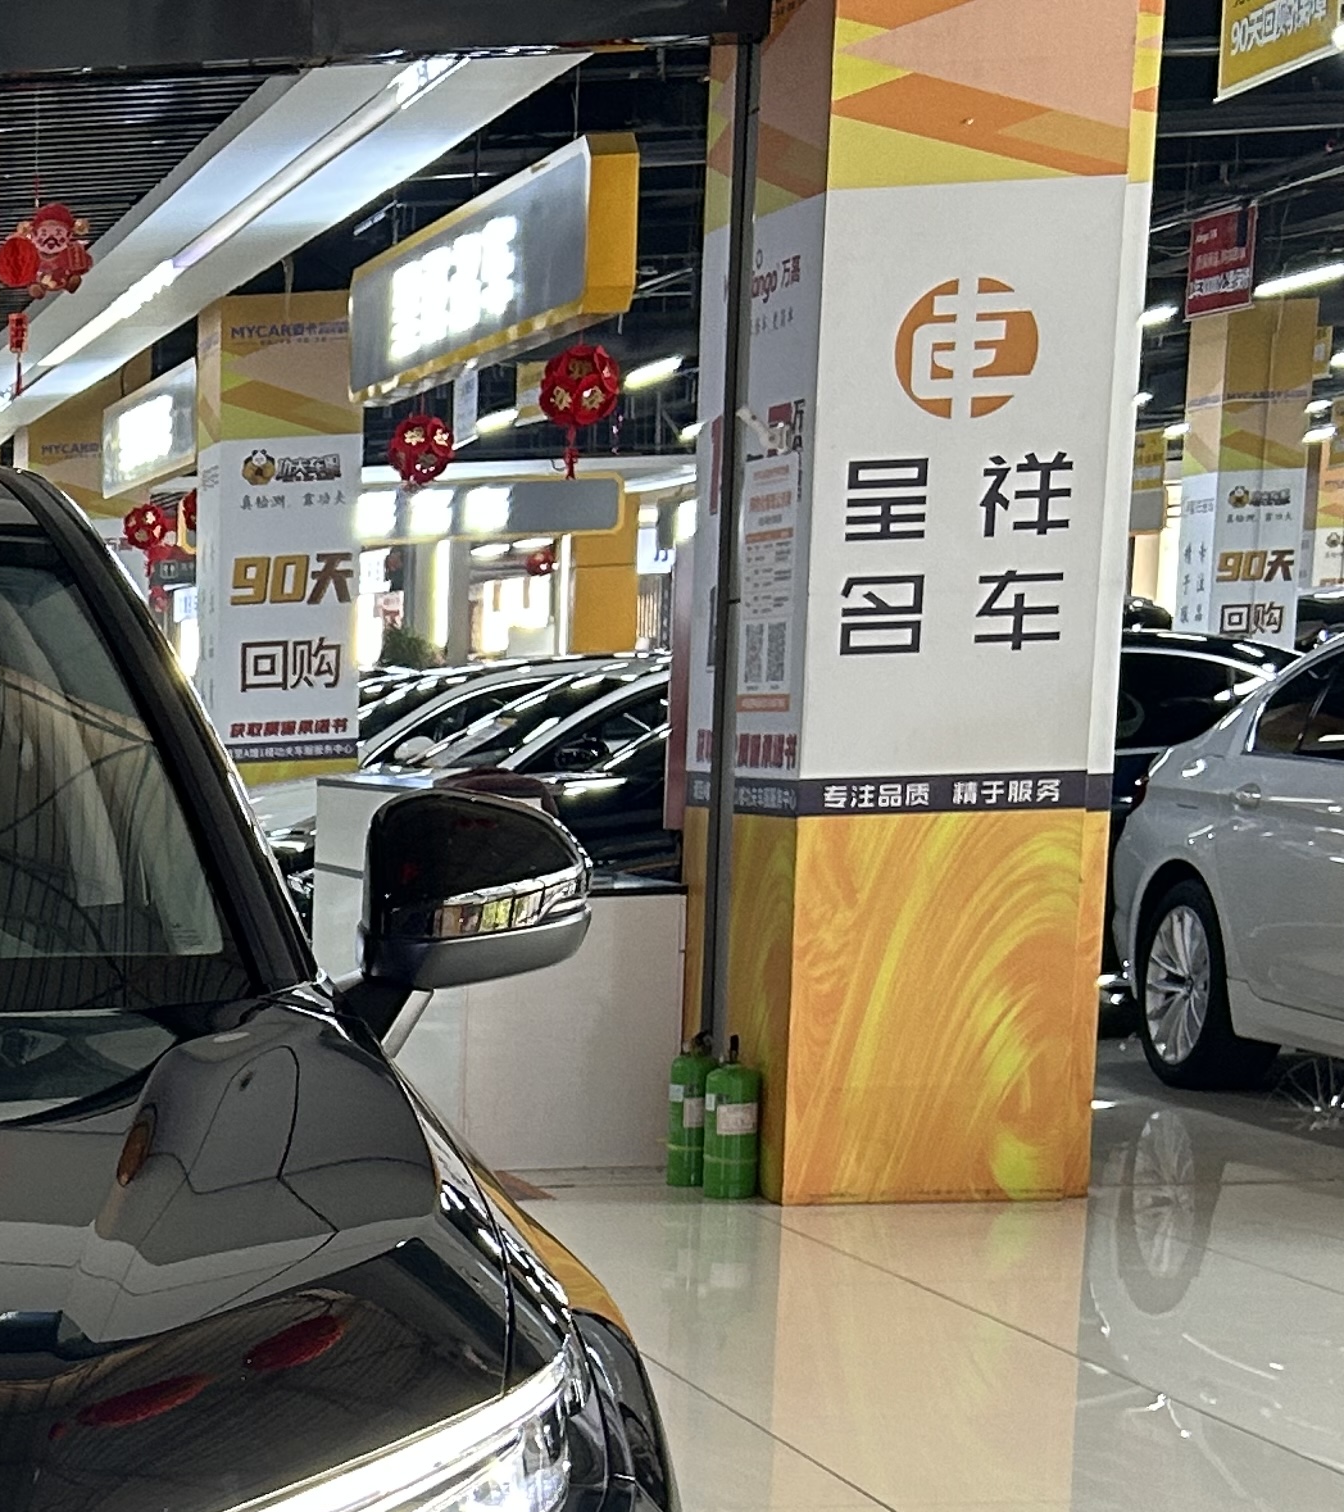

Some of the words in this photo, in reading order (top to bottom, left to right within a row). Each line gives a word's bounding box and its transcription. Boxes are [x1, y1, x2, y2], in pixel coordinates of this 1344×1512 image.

[230, 552, 354, 606] 90天
[1216, 549, 1294, 582] 90天
[1219, 602, 1283, 634] 回购
[240, 637, 342, 693] 回购
[823, 784, 930, 808] 专注品质
[952, 779, 1062, 804] 精于服务
